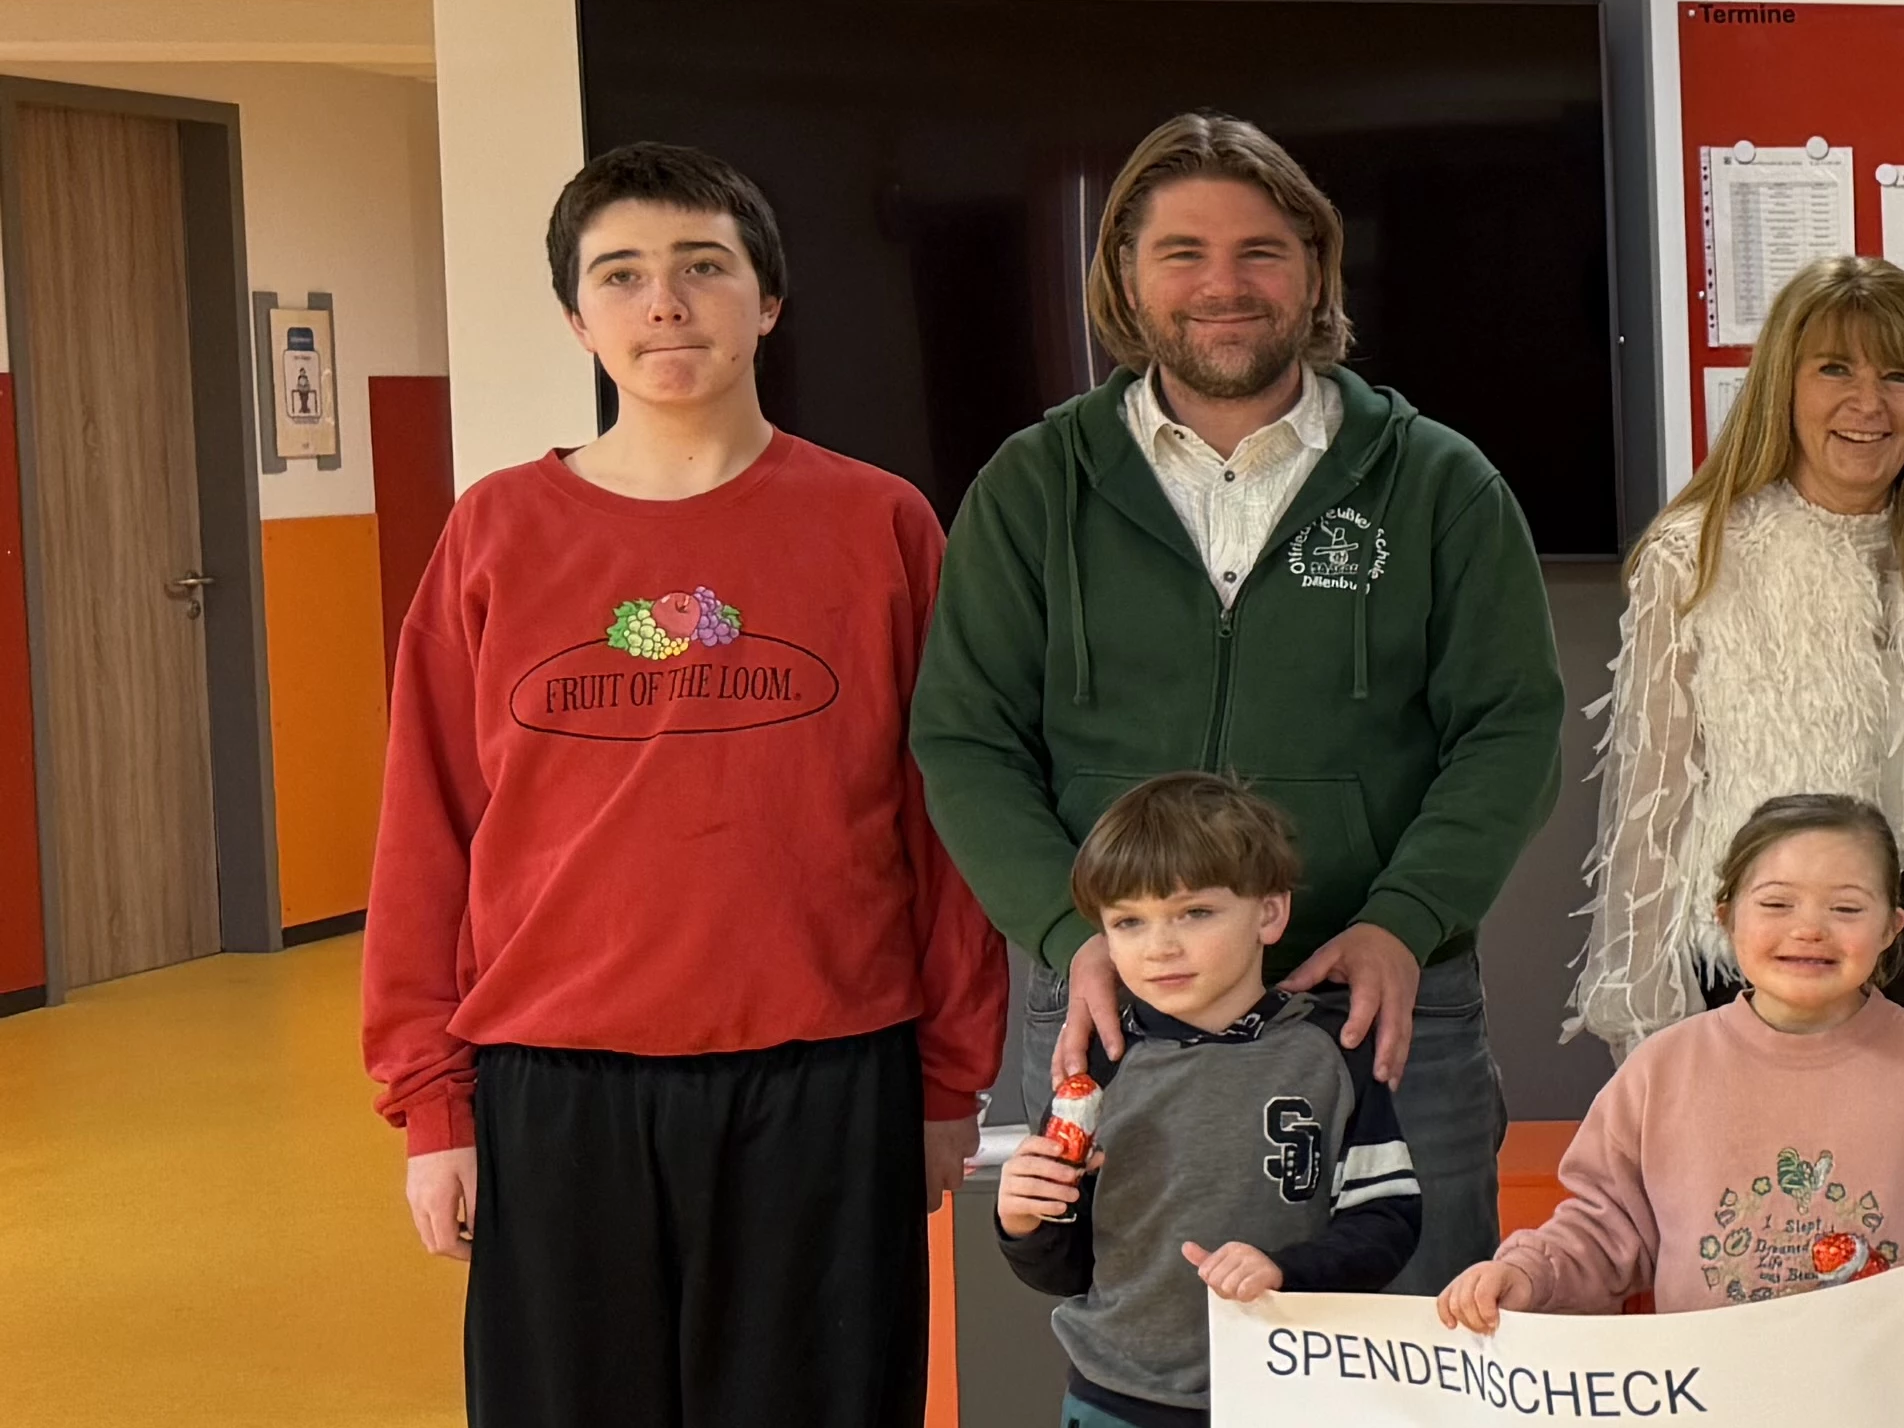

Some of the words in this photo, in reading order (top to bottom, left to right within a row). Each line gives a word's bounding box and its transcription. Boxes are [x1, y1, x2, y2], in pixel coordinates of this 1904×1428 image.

[1698, 3, 1796, 24] Termine
[546, 673, 624, 713] FRUIT
[630, 672, 663, 707] OF
[668, 663, 712, 702] THE
[1265, 1328, 1708, 1418] SPENDENSCHECK
